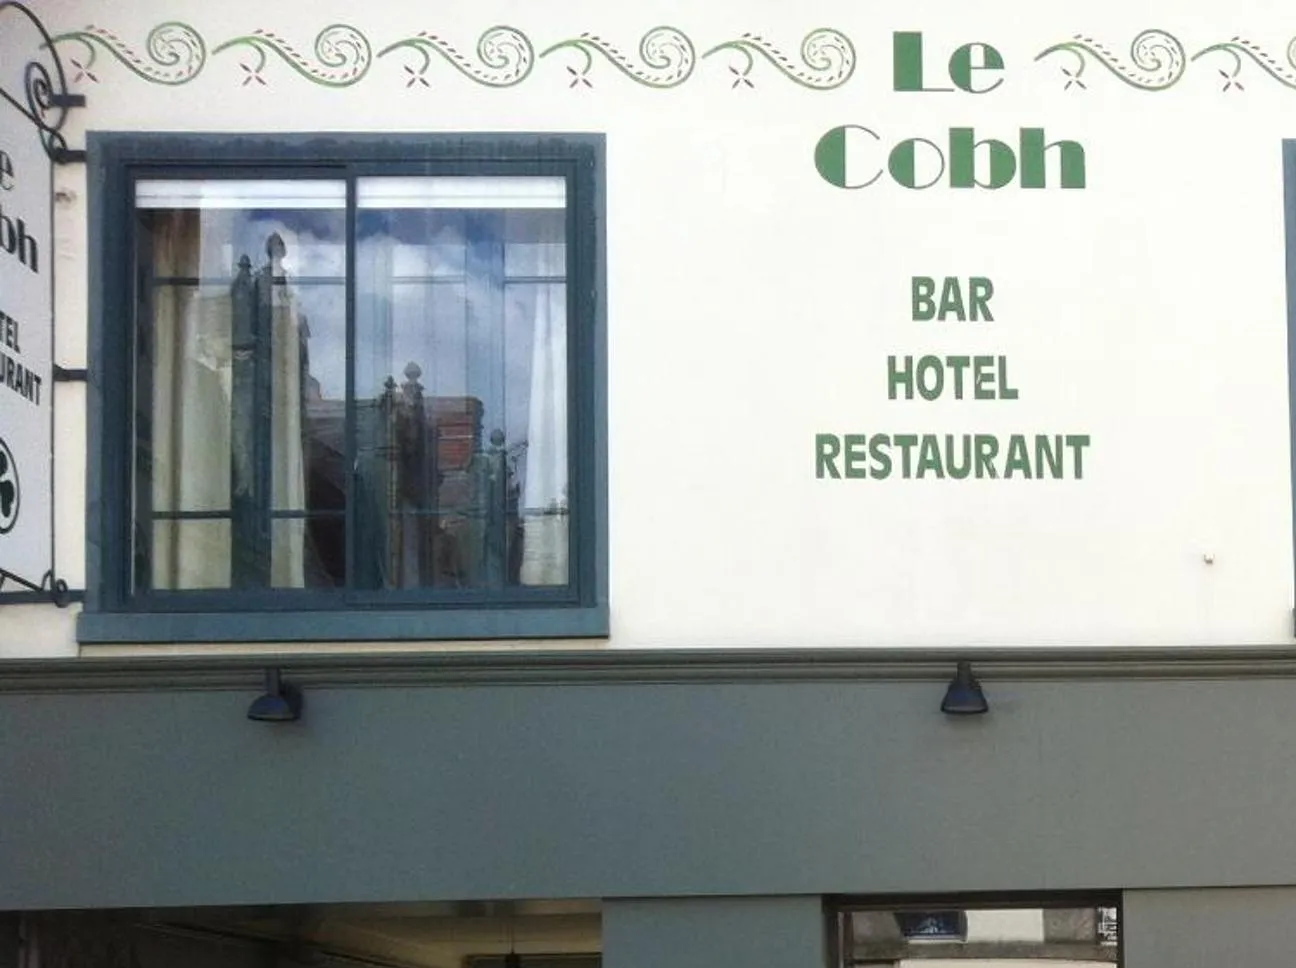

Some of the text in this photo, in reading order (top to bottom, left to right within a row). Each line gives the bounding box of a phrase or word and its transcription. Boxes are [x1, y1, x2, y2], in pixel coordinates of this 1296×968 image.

[893, 30, 1005, 94] Le
[813, 124, 1087, 190] Cobh
[911, 276, 995, 322] BAR
[887, 354, 1019, 402] HOTEL
[815, 432, 1091, 481] RESTAURANT
